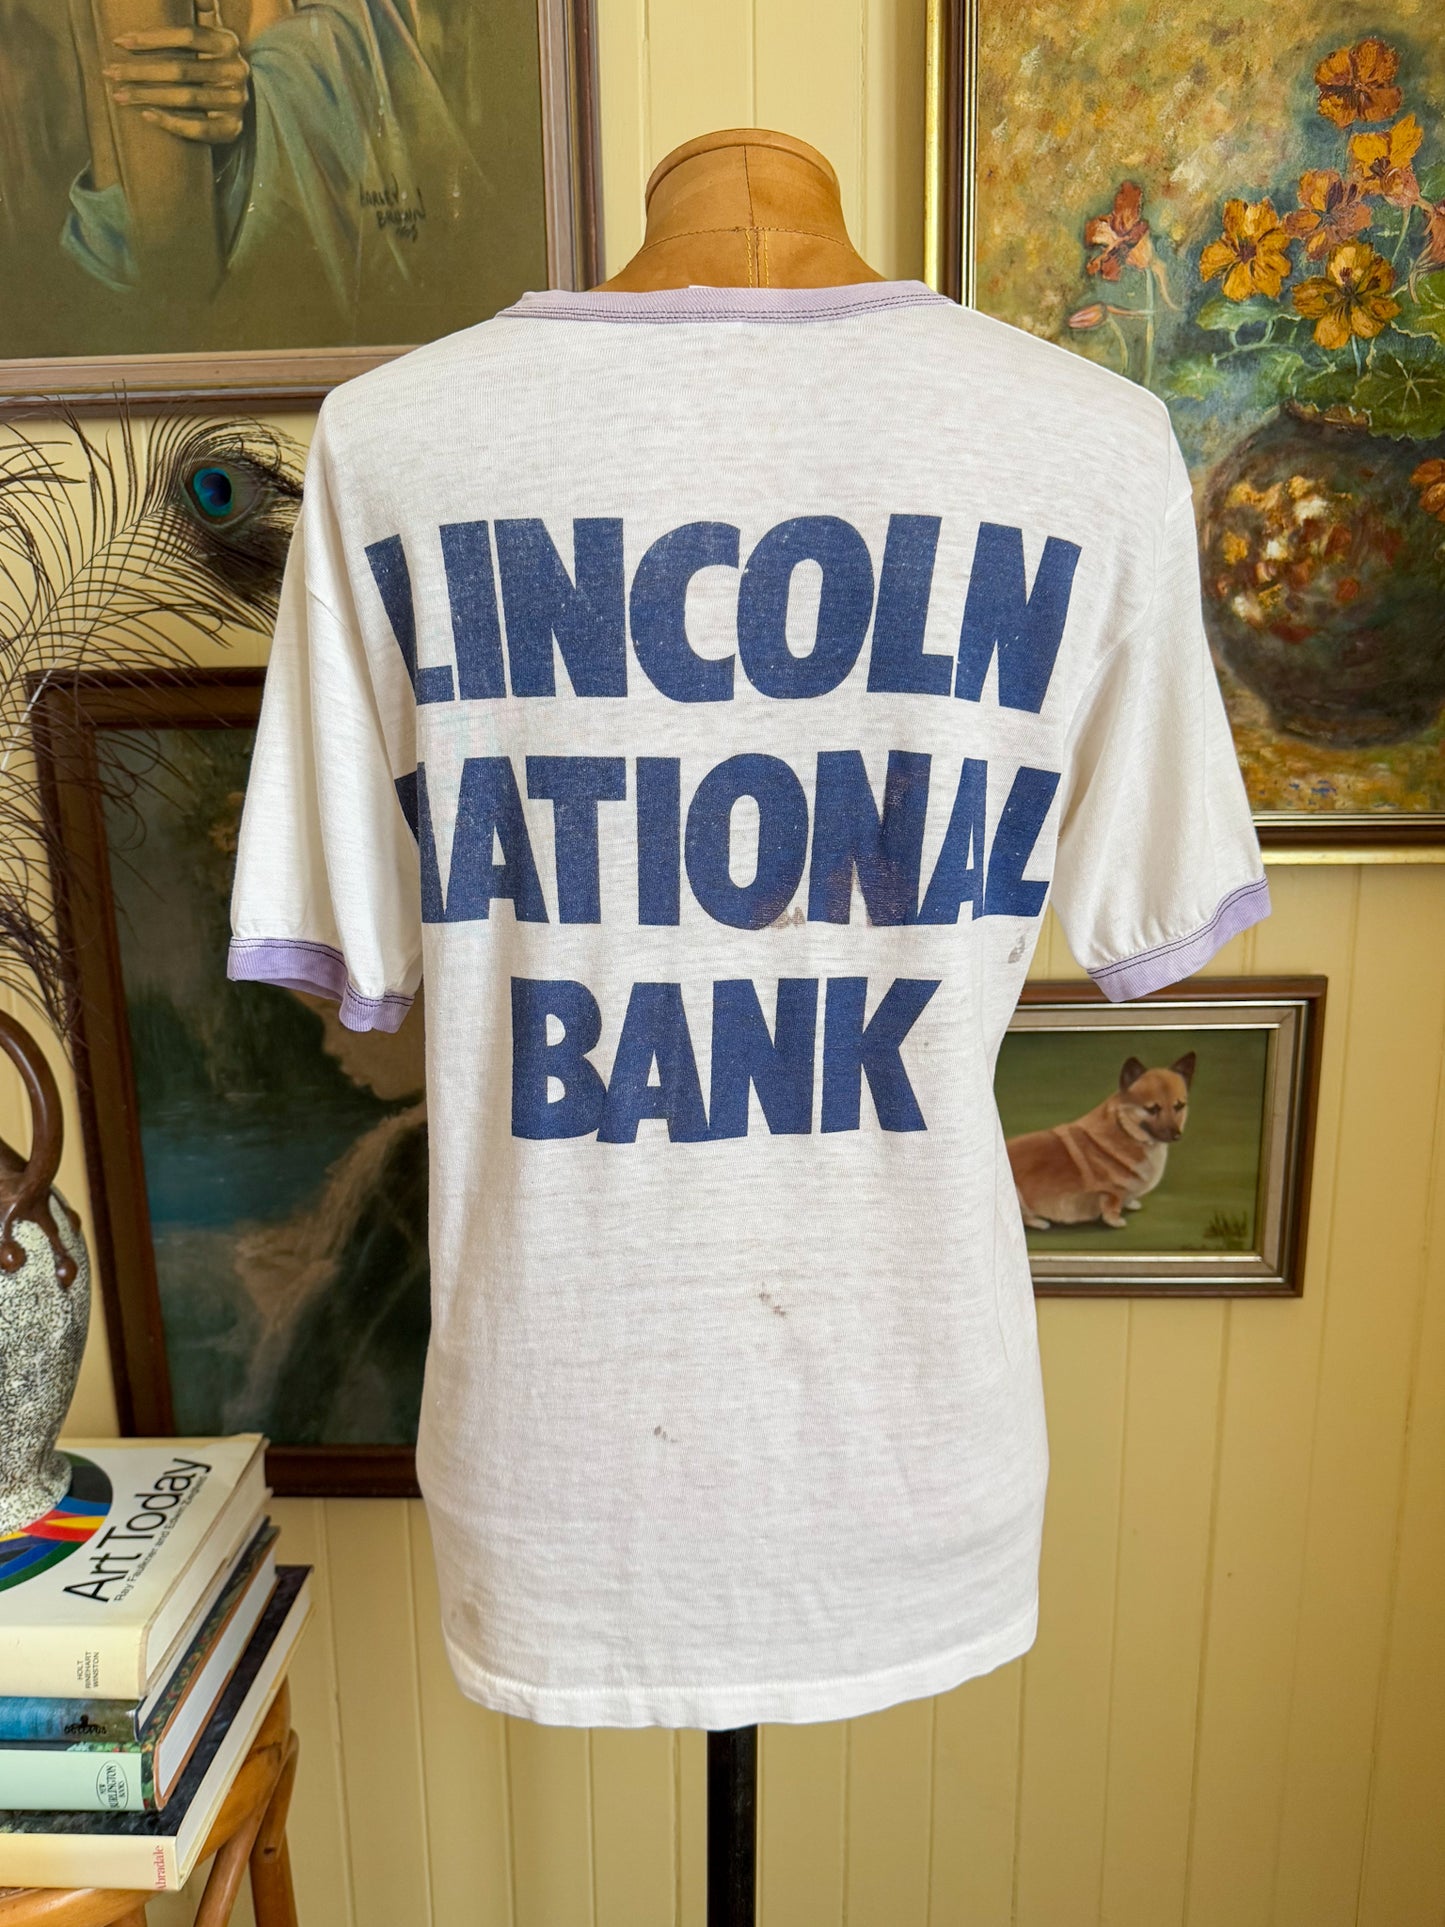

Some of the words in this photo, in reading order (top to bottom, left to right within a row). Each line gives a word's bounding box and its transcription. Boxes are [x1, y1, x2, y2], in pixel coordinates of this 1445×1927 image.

[365, 513, 1083, 713] LINCOLN
[511, 976, 942, 1143] BANK
[96, 1457, 213, 1549] Today
[62, 1553, 143, 1603] Art
[114, 1583, 135, 1602] Ray
[76, 1660, 84, 1681] HOLT
